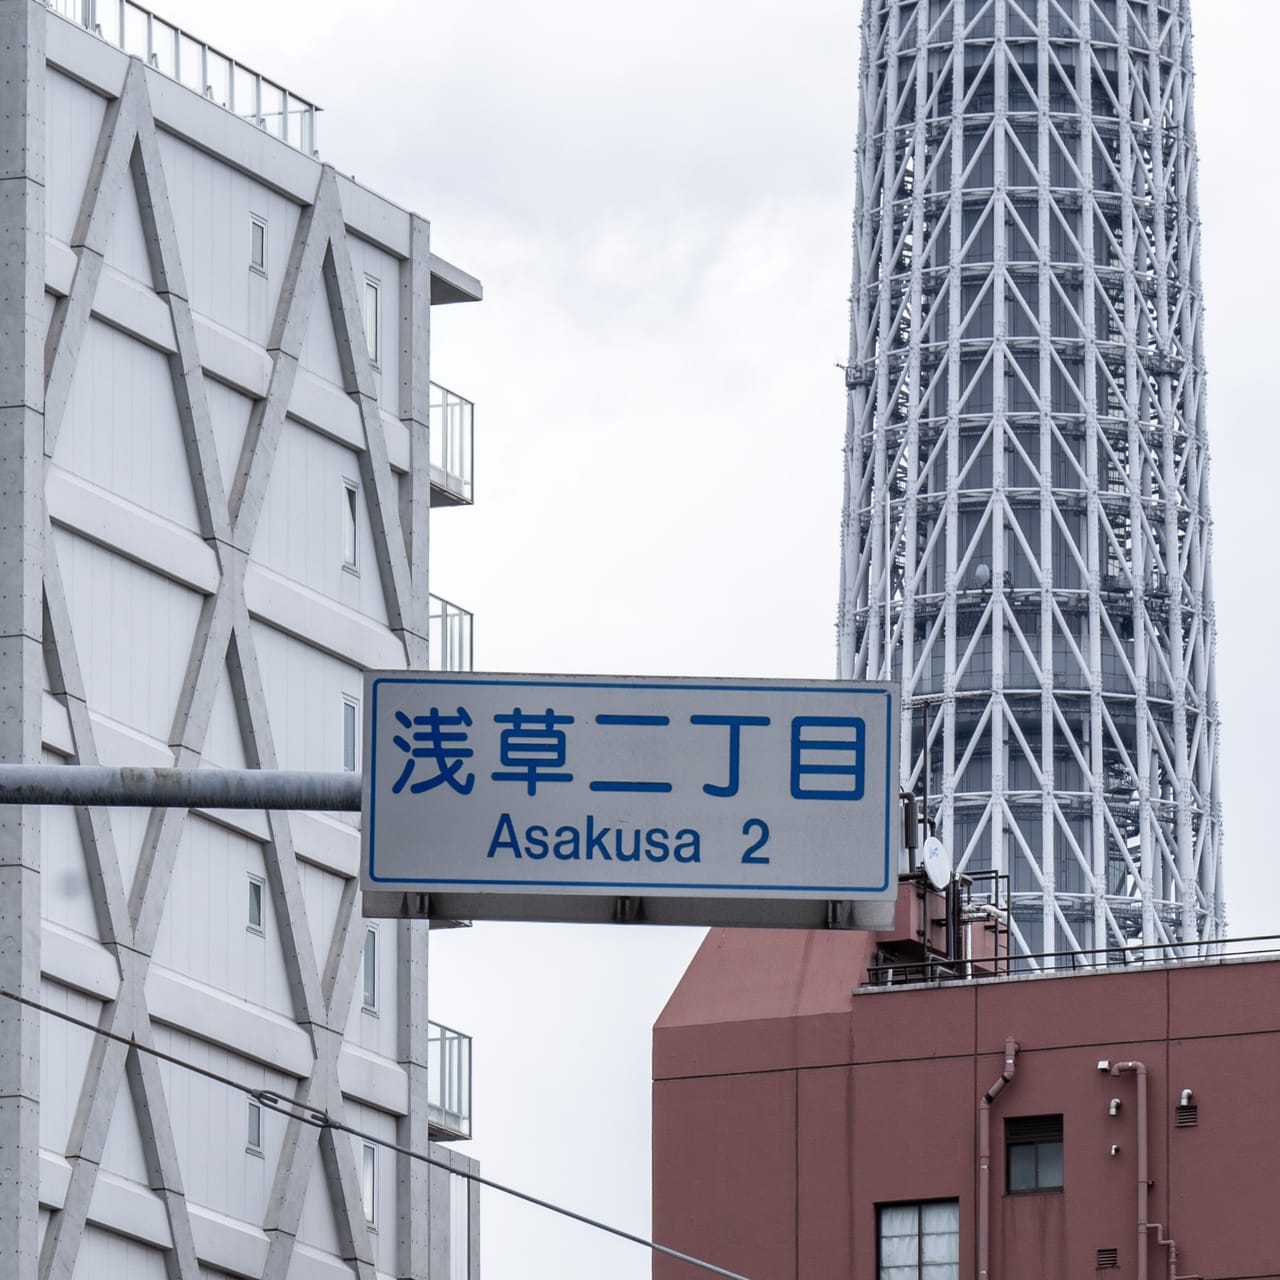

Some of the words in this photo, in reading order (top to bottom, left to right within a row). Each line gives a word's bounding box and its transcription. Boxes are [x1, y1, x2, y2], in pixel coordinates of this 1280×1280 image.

[392, 707, 866, 801] 浅草二丁目
[486, 813, 702, 864] Asakusa
[741, 818, 771, 864] 2
